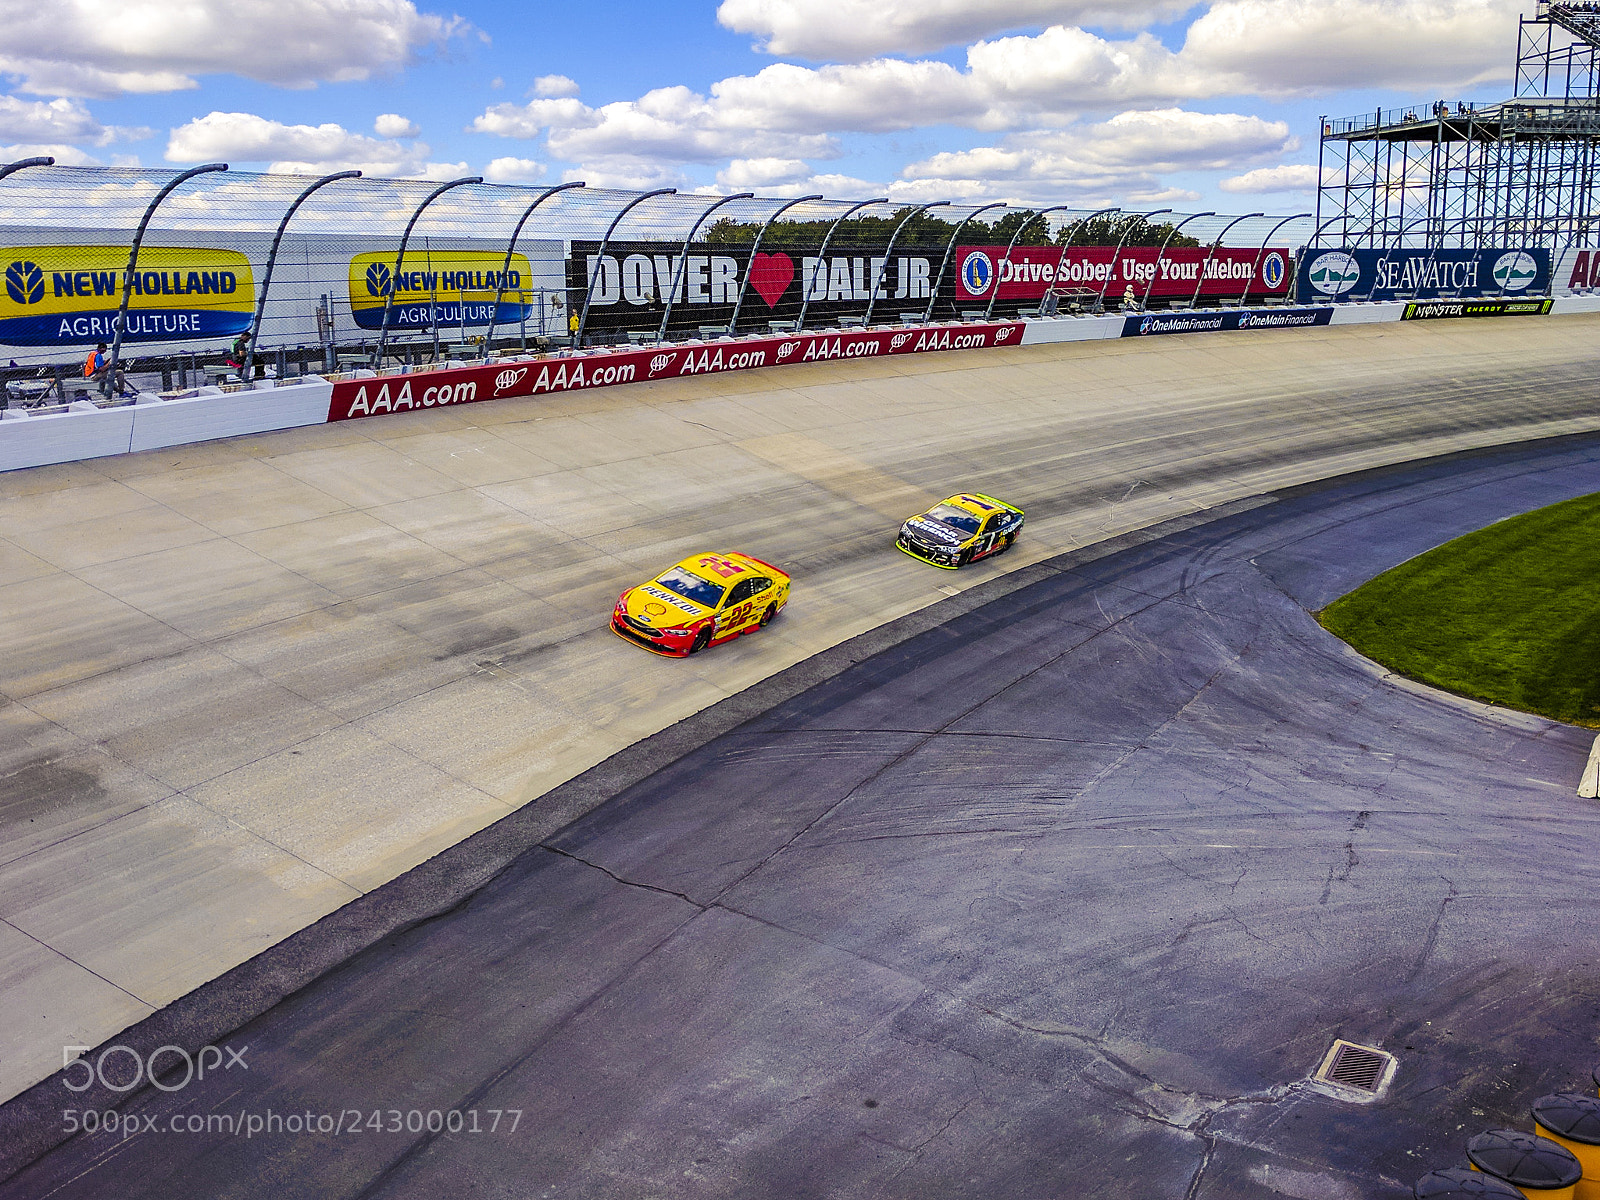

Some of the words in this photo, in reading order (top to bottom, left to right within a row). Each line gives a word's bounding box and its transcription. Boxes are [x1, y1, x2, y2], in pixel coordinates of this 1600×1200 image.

[396, 271, 438, 291] NEW
[443, 270, 520, 291] HOLLAND
[586, 253, 738, 305] DOVER
[802, 256, 887, 300] DALE
[997, 258, 1054, 282] Drive
[1058, 258, 1117, 282] Sober.
[1122, 258, 1156, 280] Use
[1160, 258, 1199, 280] Your
[1203, 257, 1256, 279] Melon.
[53, 271, 116, 297] NEW
[123, 271, 236, 296] HOLLAND
[58, 314, 200, 337] AGRICULTURE
[398, 305, 495, 324] AGRICULTURE
[347, 381, 476, 417] AAA.com
[532, 362, 636, 393] AAA.com
[680, 348, 765, 374] AAA.com
[803, 337, 880, 361] AAA.com
[914, 330, 986, 351] AAA.com
[641, 586, 702, 615] PENNZOIL
[727, 602, 752, 631] 22
